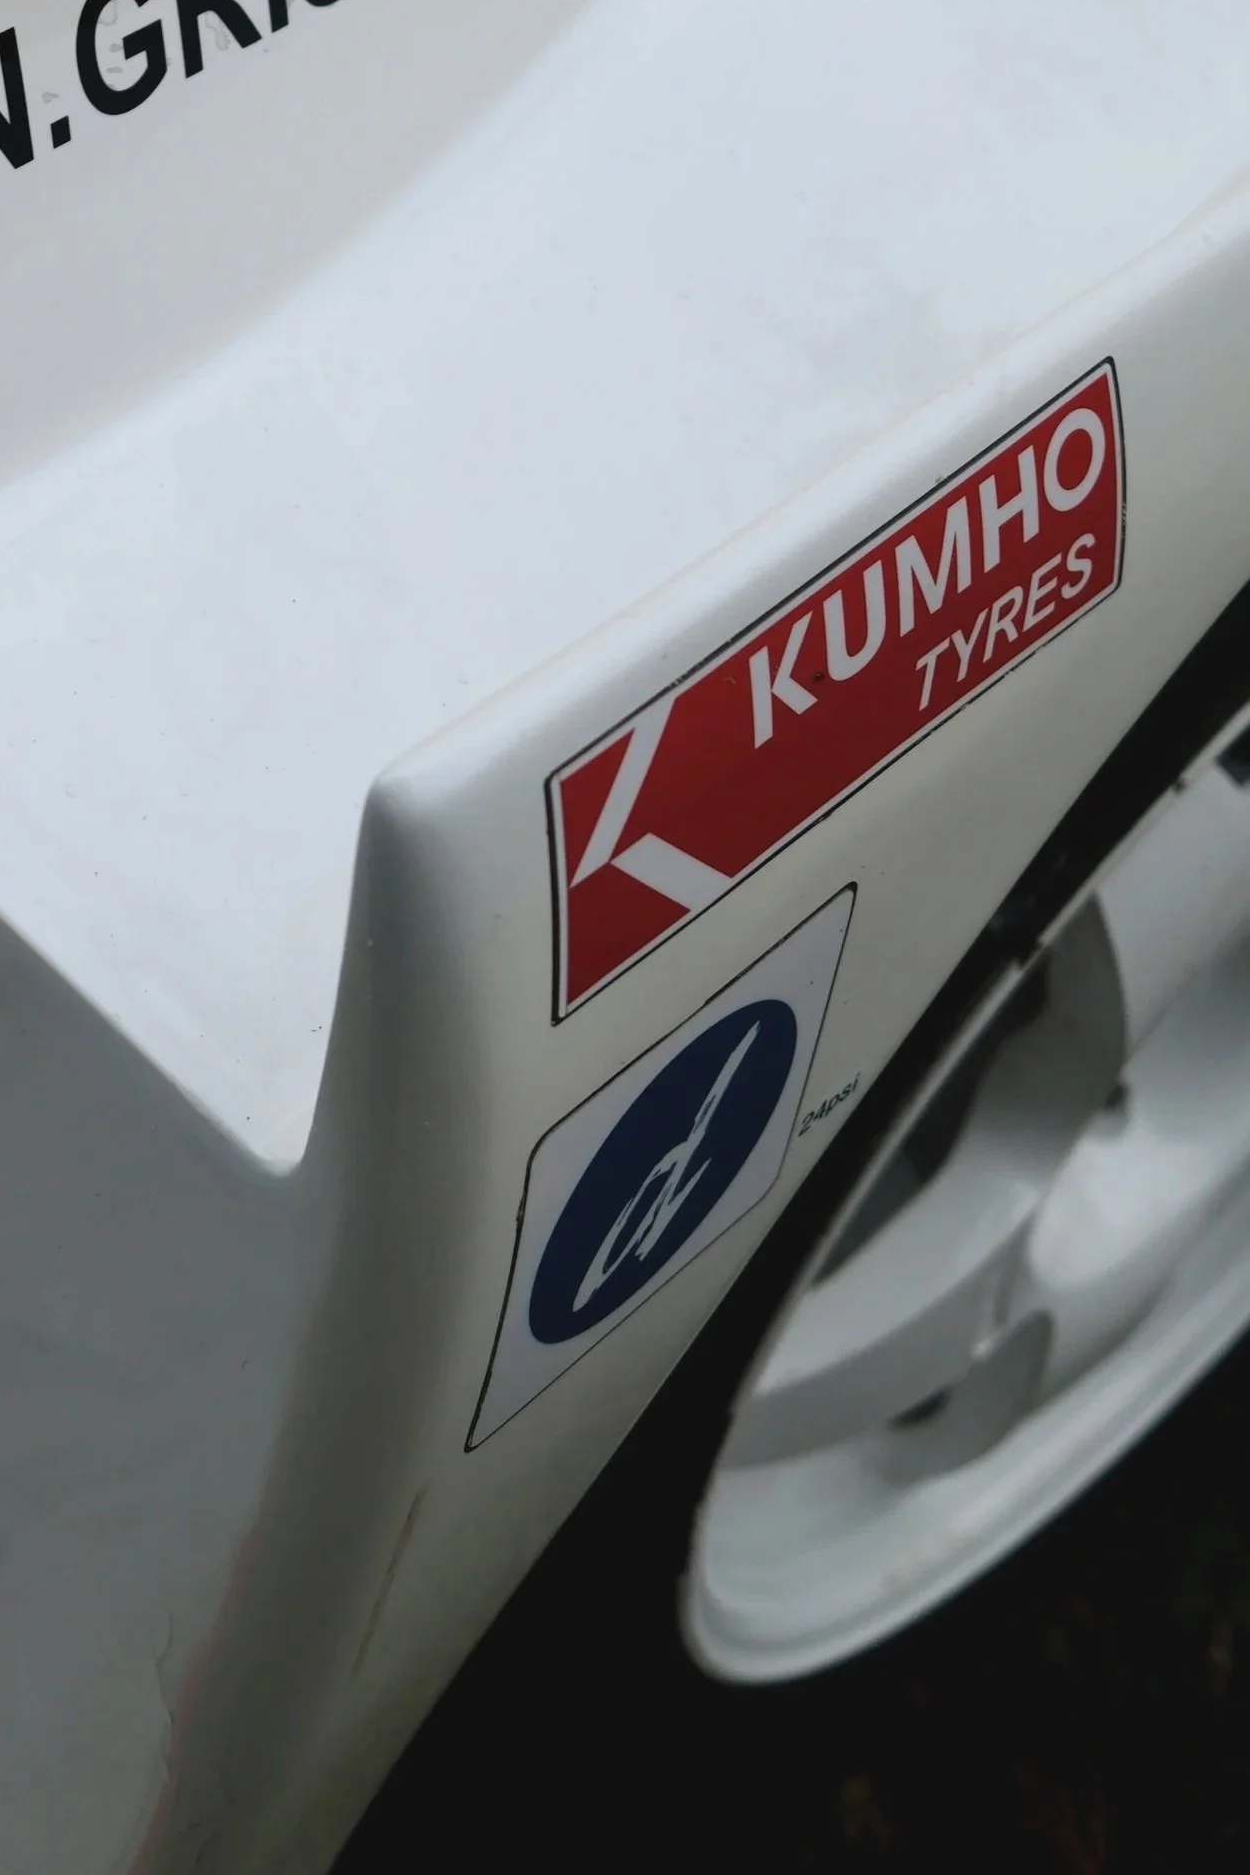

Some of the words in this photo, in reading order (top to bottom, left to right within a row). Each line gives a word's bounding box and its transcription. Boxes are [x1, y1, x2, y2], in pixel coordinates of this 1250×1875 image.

[749, 408, 1105, 749] KUMHO
[915, 533, 1095, 710] TYRES
[797, 1071, 860, 1137] 24psi
